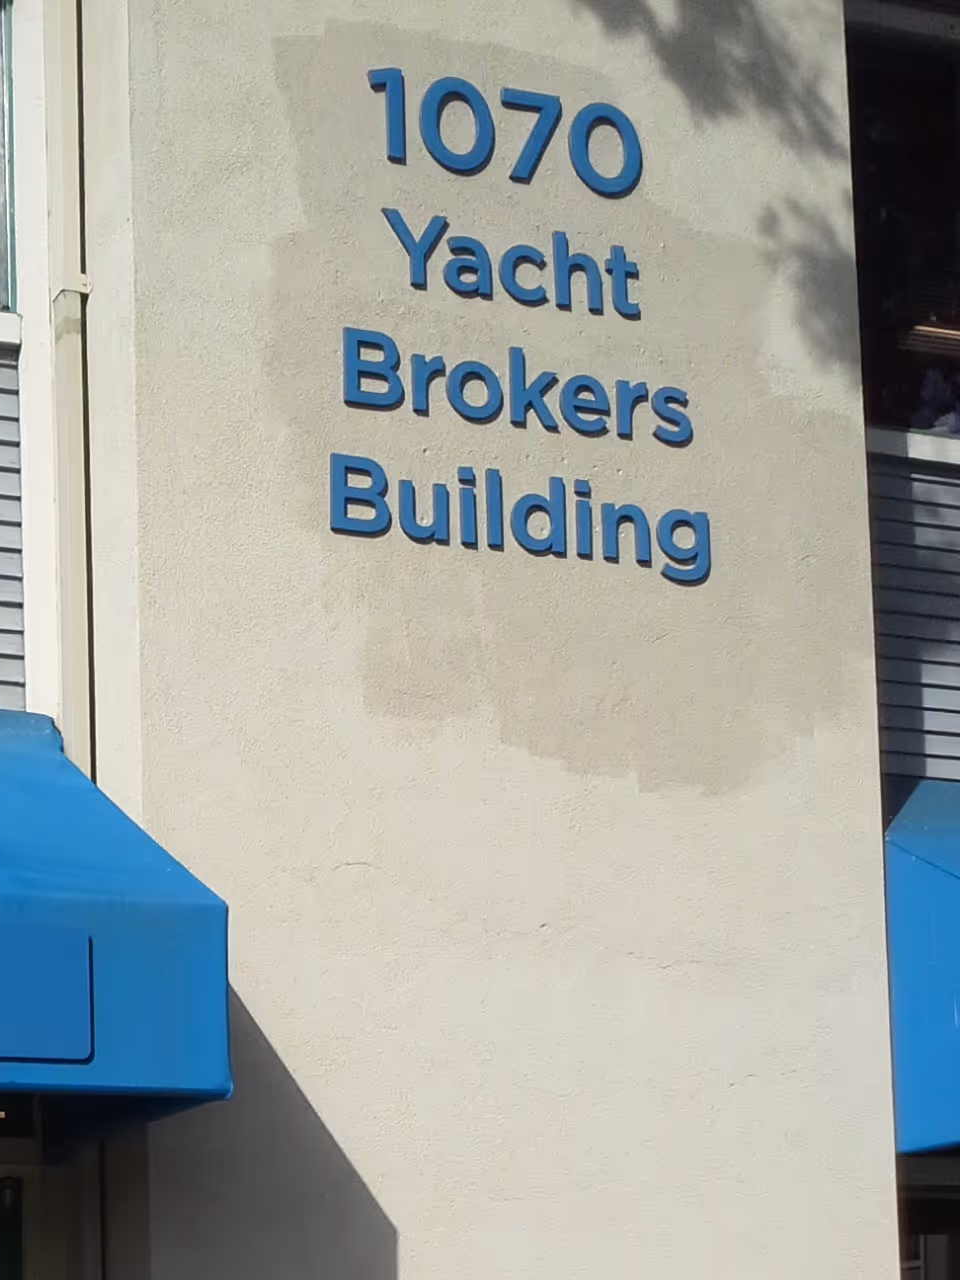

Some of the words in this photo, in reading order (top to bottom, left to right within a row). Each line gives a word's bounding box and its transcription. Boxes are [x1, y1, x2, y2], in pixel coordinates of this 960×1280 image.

[367, 65, 644, 199] 1070
[381, 207, 641, 320] Yacht
[342, 326, 695, 447] Brokers
[329, 452, 712, 587] Building
